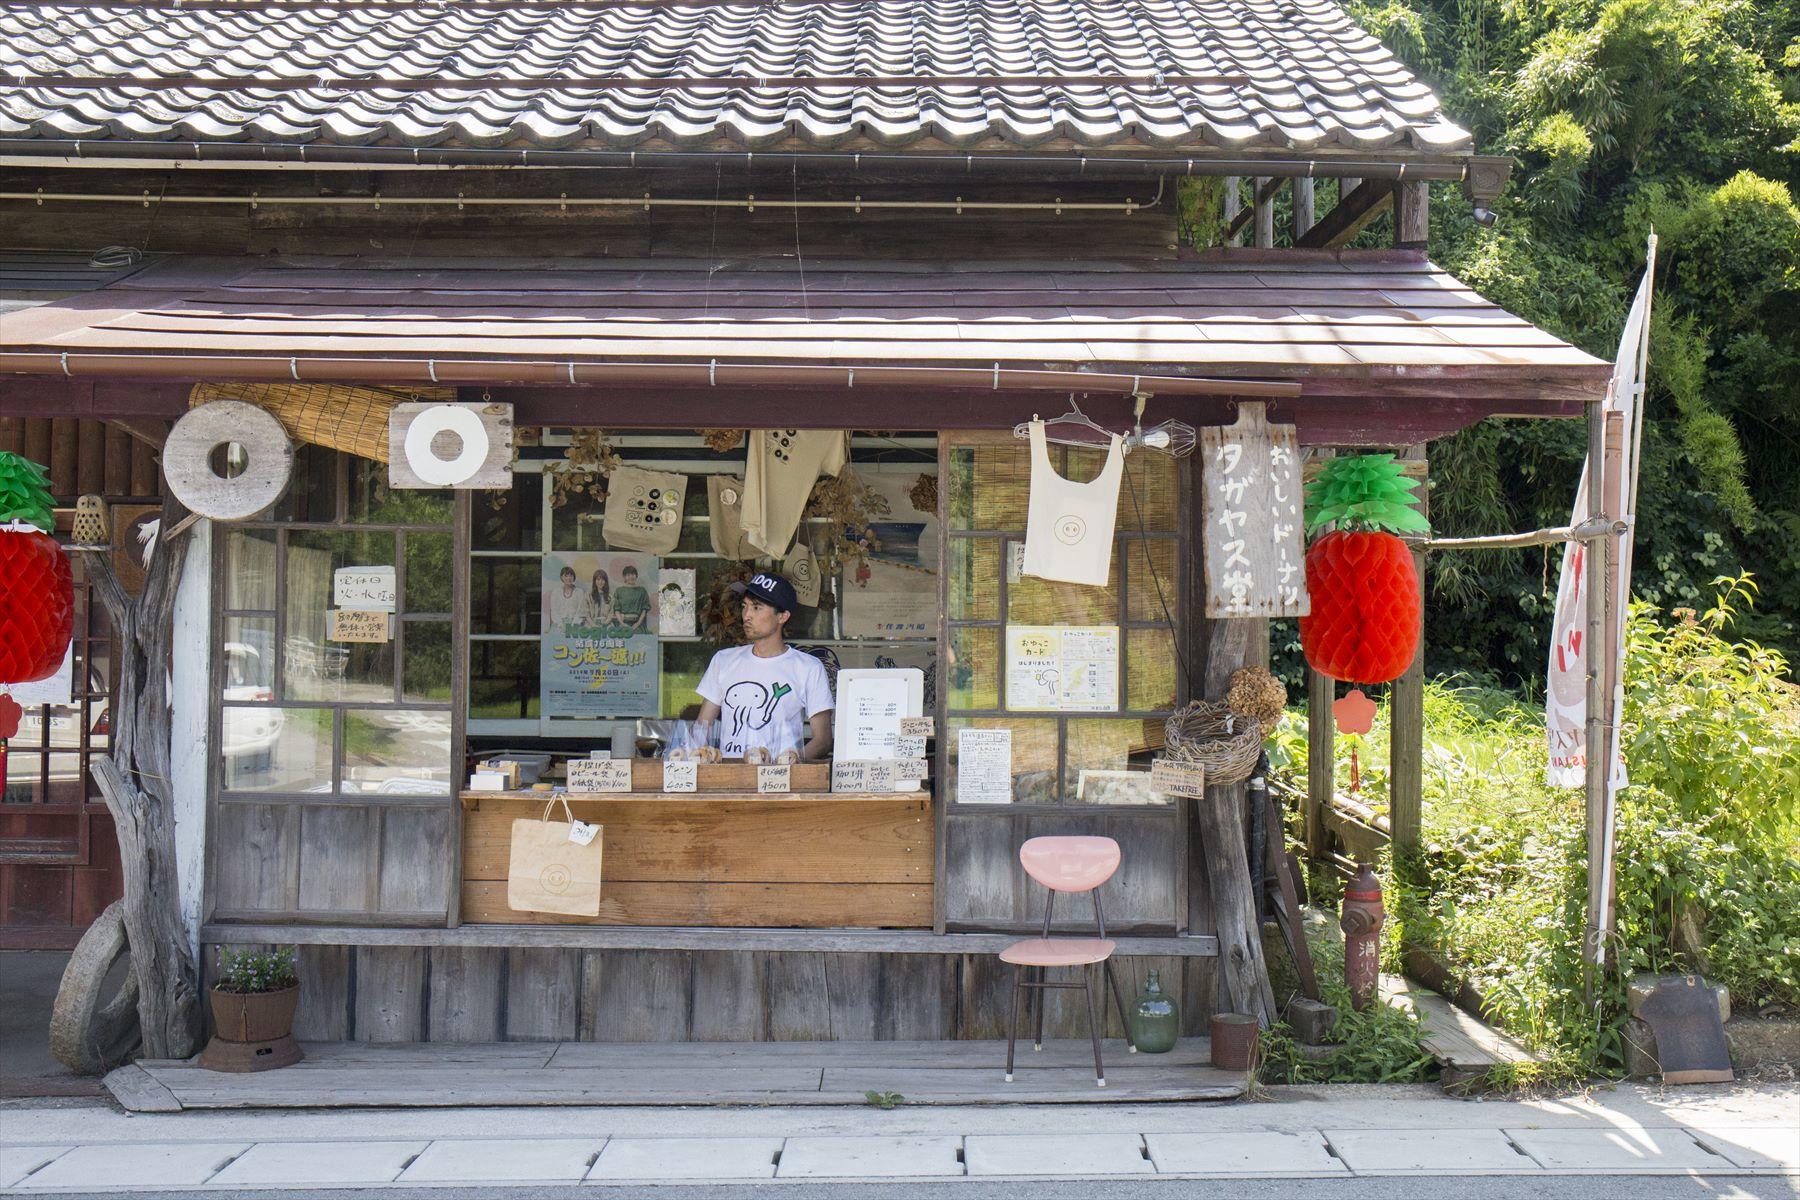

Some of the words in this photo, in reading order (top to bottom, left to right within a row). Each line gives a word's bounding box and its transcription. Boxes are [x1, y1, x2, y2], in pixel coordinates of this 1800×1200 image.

[1217, 444, 1255, 612] タガヤス堂
[1270, 446, 1298, 606] おいしいドーナツ
[340, 576, 381, 585] 定休日
[565, 623, 634, 640] Negicco
[1026, 648, 1045, 656] カード
